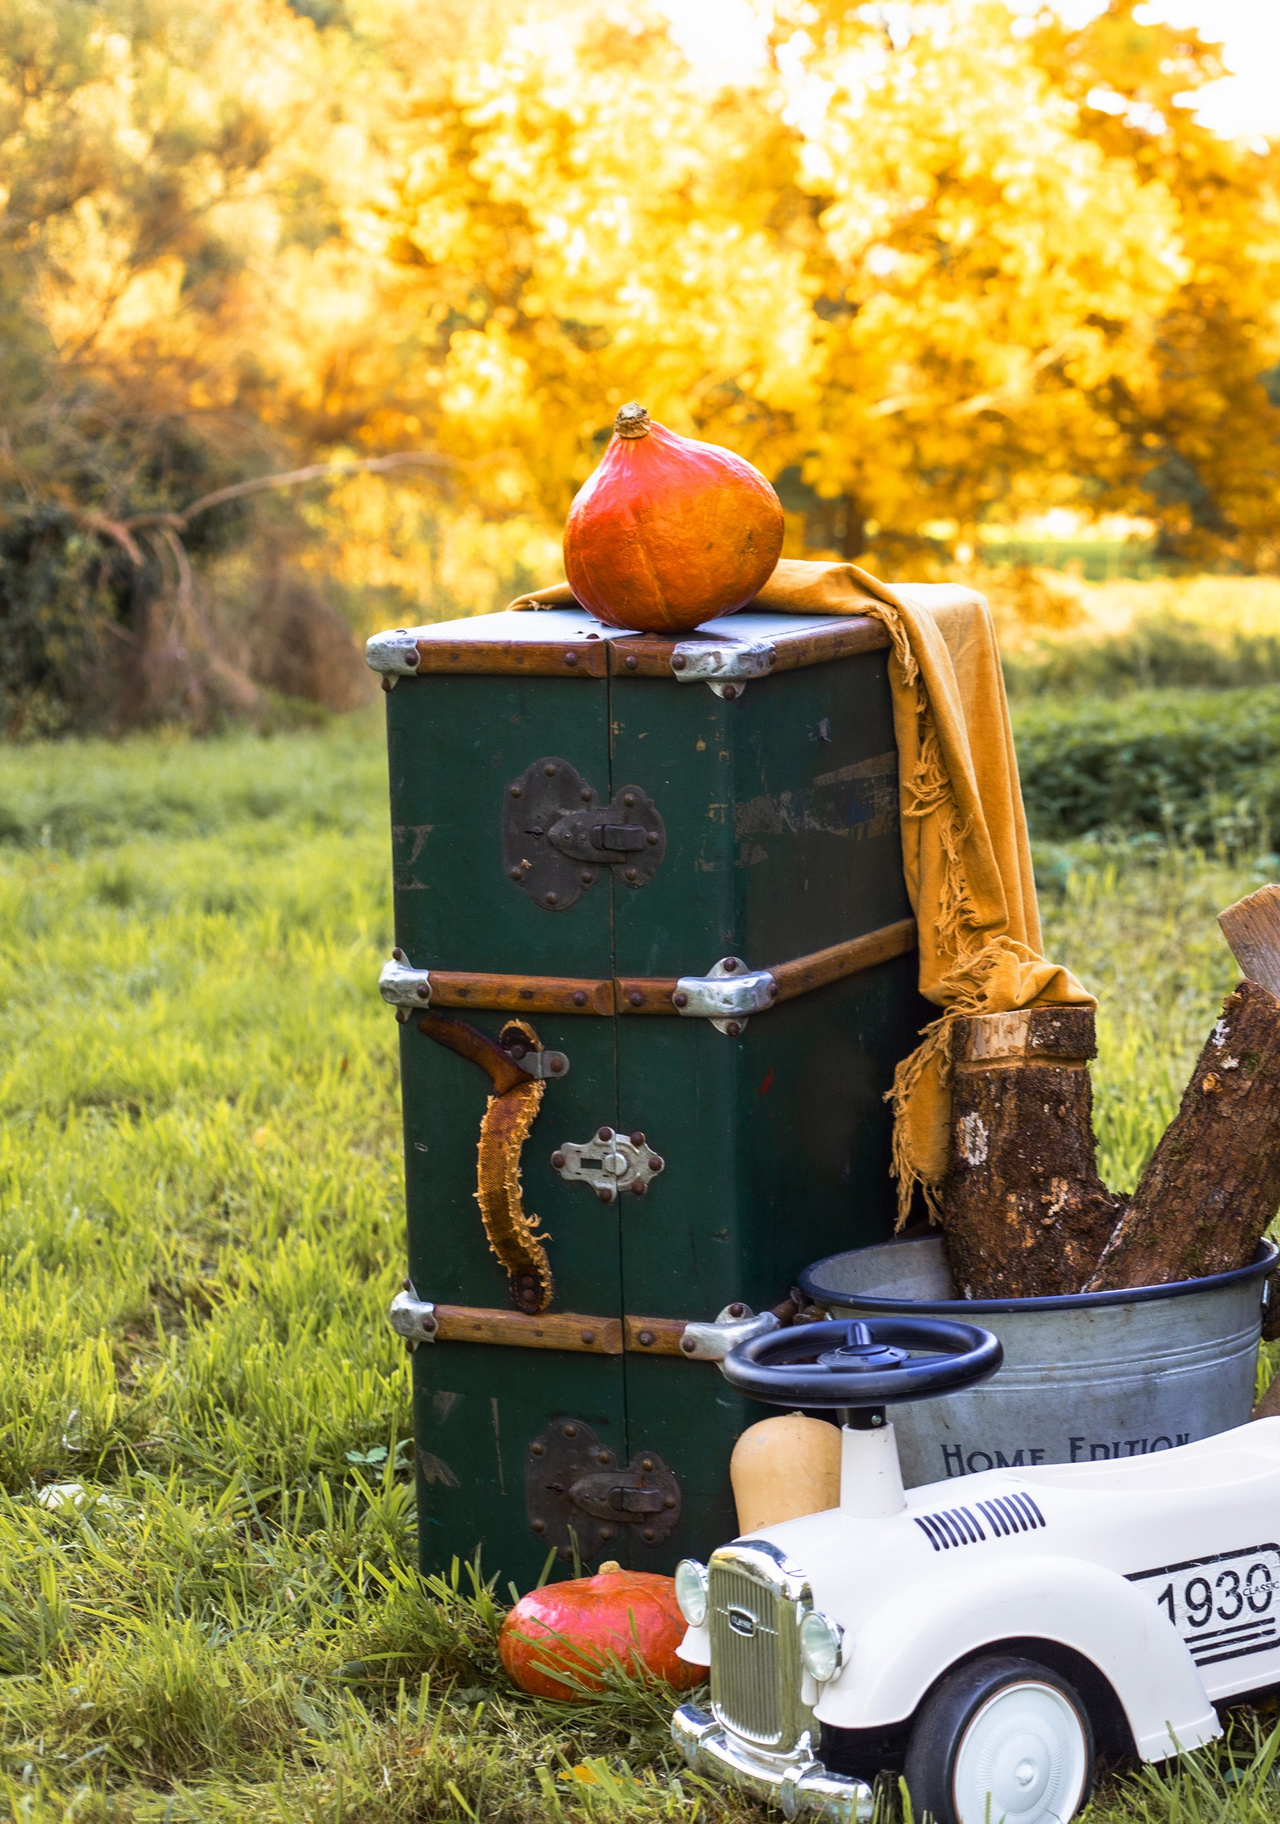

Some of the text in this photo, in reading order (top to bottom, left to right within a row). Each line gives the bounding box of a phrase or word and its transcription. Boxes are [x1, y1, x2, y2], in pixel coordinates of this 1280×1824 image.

[940, 1443, 1045, 1476] HOME
[1157, 1563, 1273, 1628] 1930
[1242, 1581, 1280, 1597] CLASSIC
